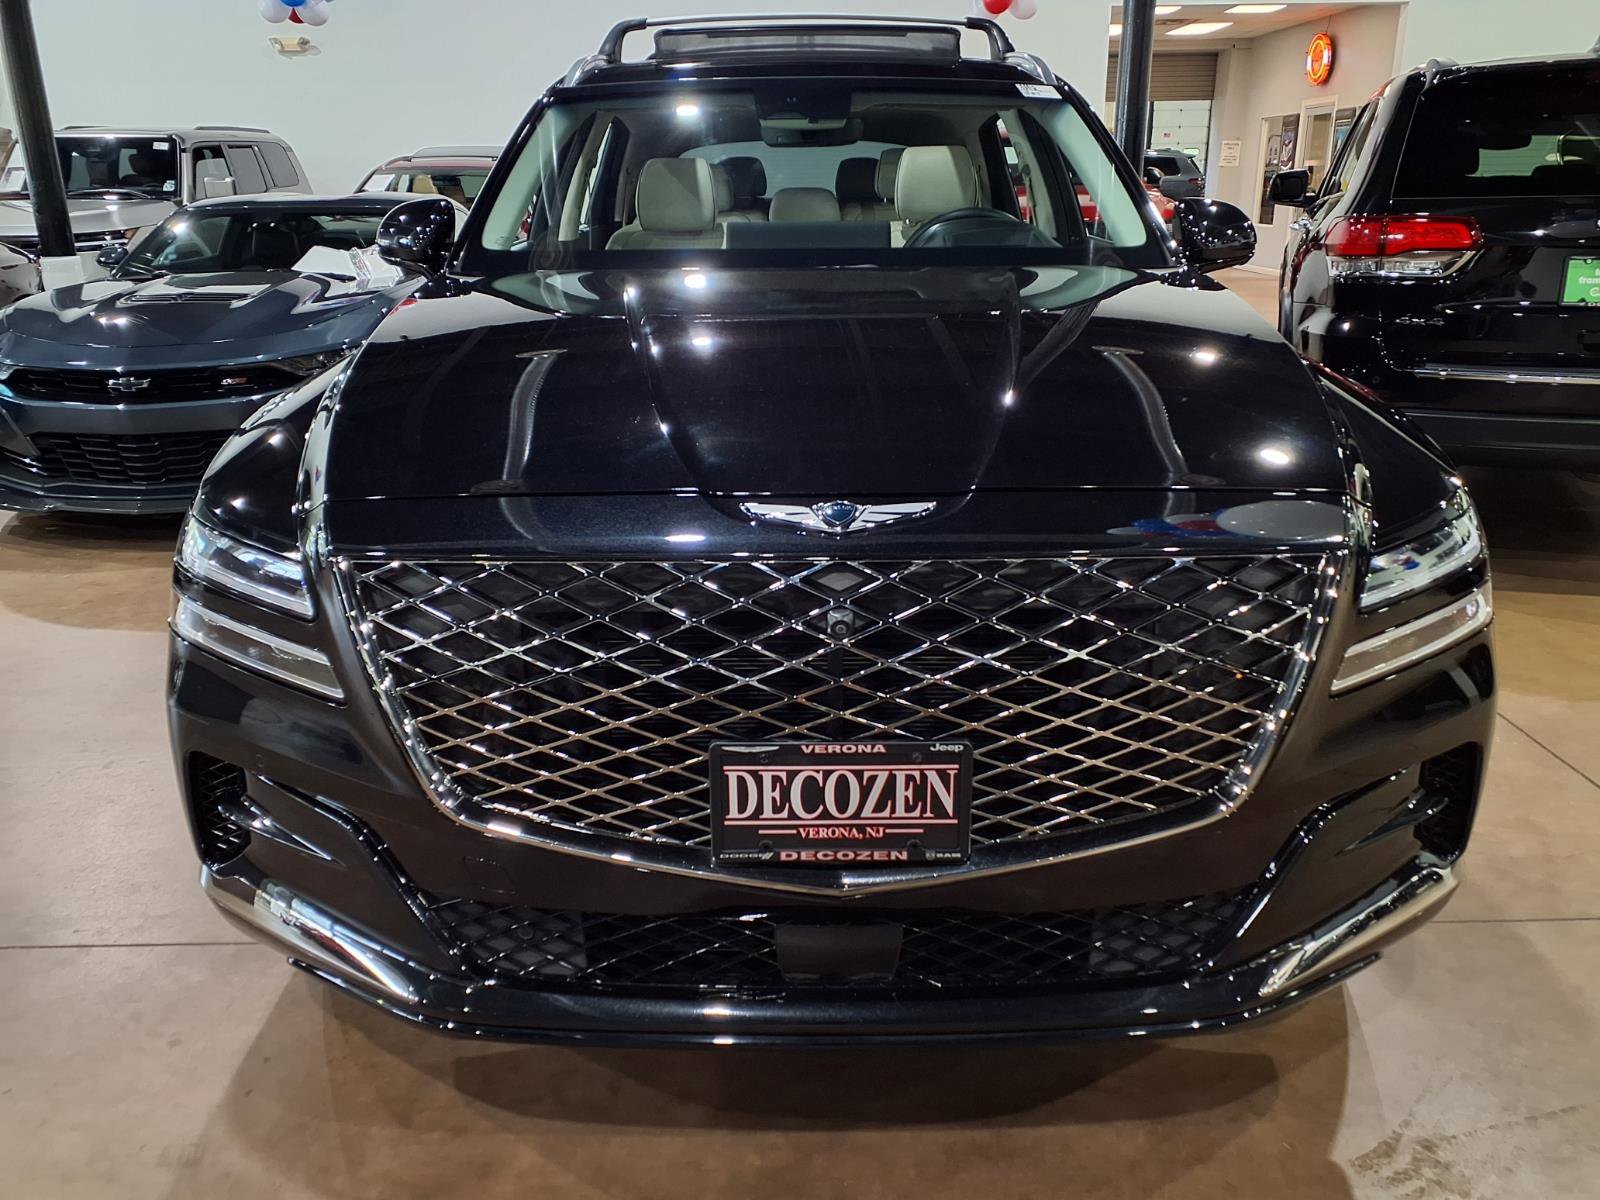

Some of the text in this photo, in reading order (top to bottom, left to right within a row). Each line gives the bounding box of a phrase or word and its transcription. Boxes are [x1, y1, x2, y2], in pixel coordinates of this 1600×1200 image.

[800, 744, 887, 754] VERONA
[930, 743, 964, 752] Jeep
[724, 769, 959, 820] DECOZEN
[797, 827, 886, 840] VERONA, NJ
[779, 850, 908, 861] DECOZEN
